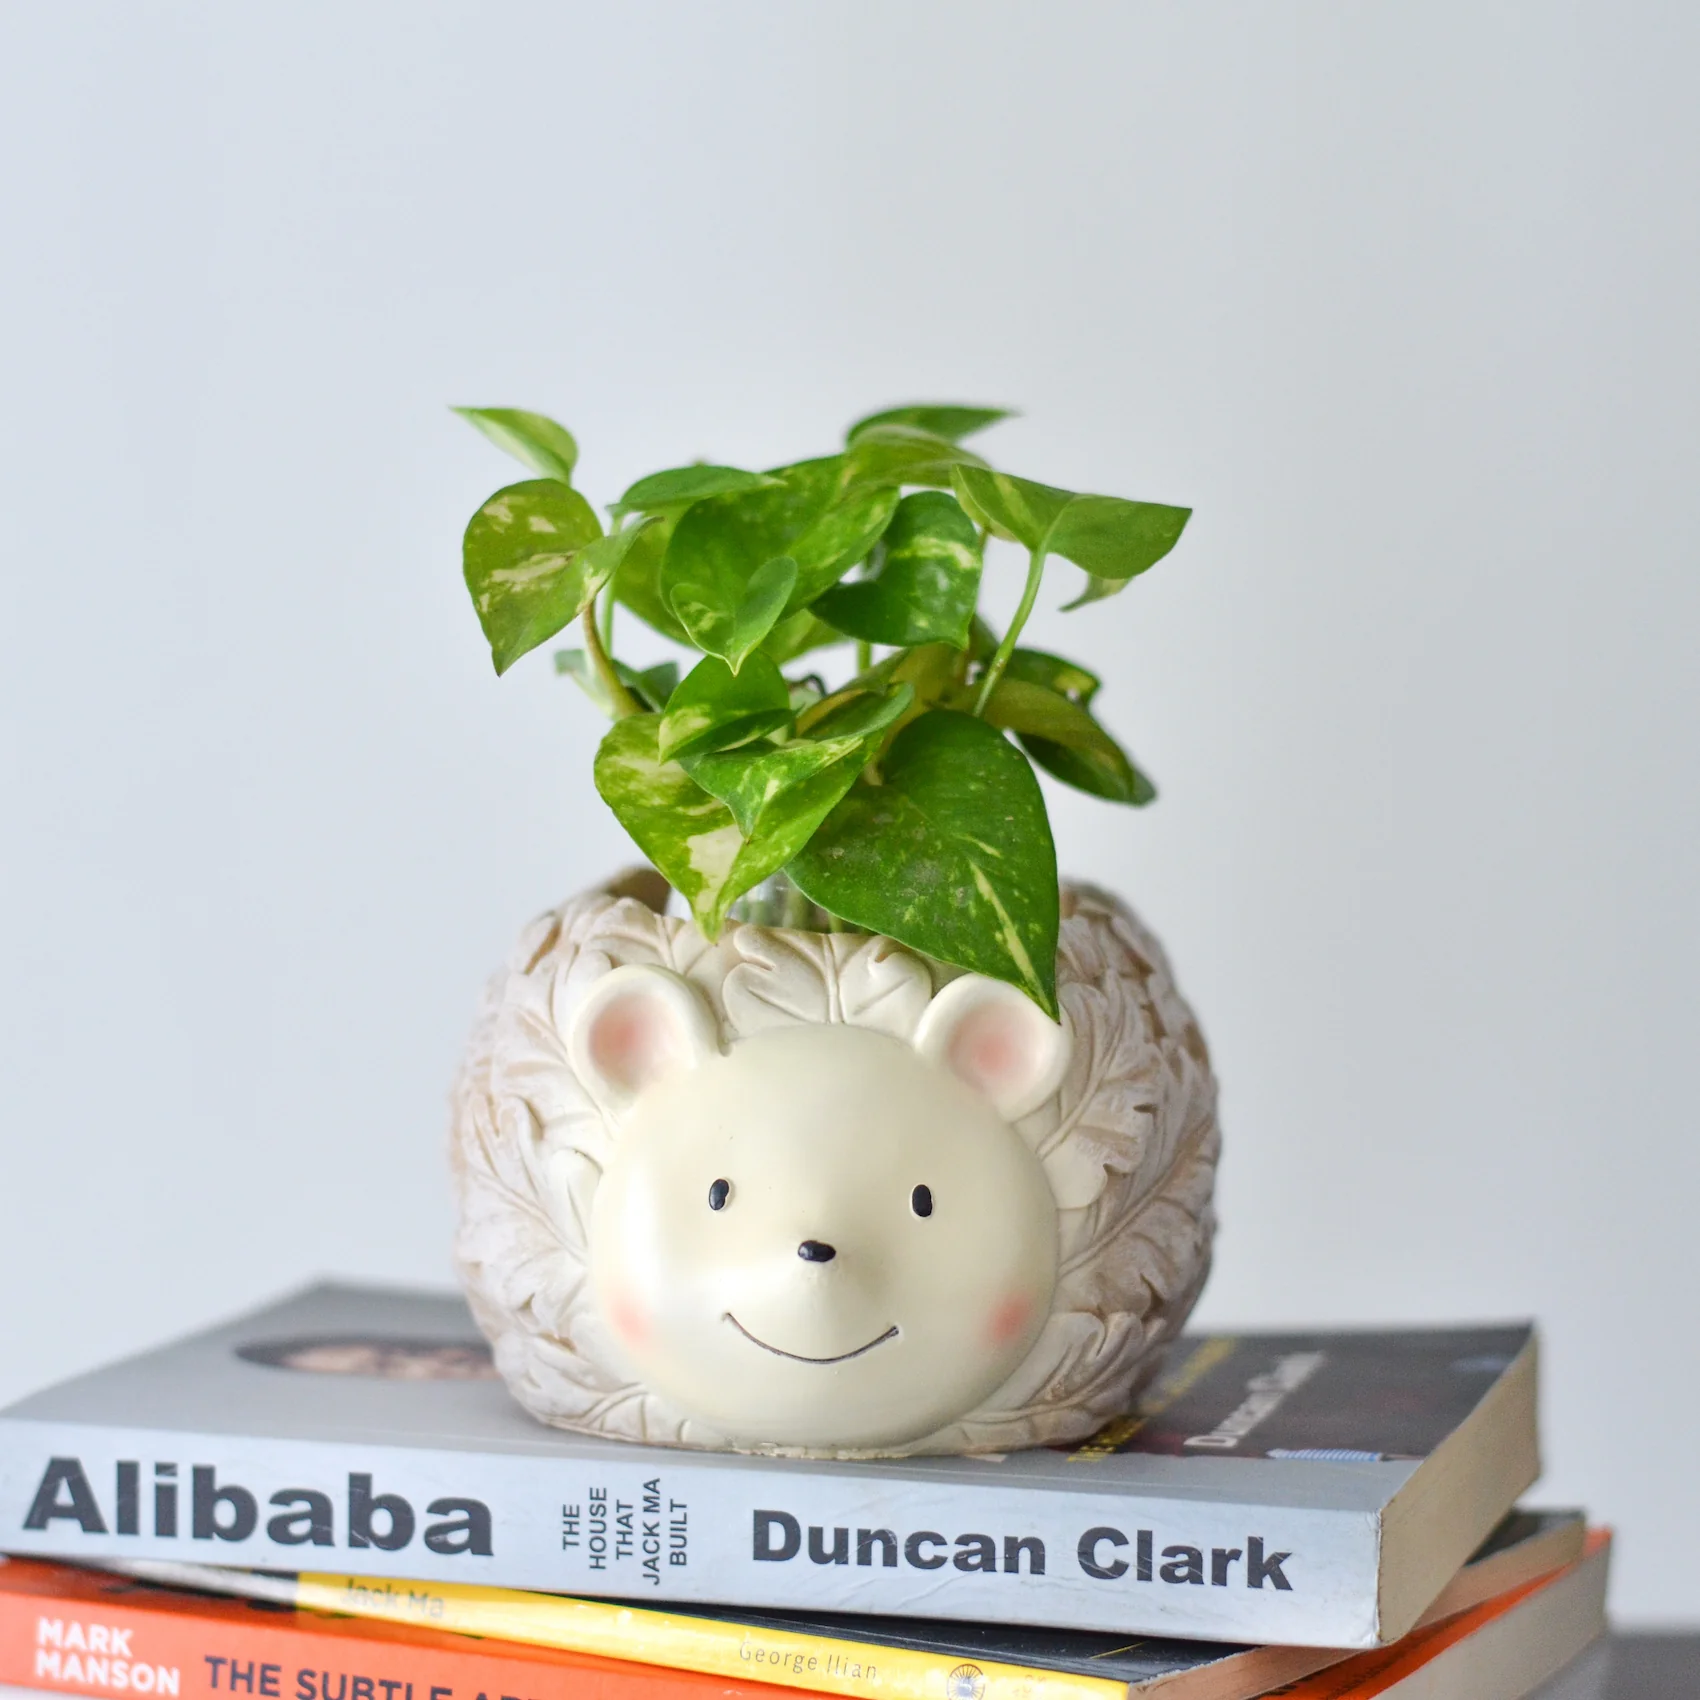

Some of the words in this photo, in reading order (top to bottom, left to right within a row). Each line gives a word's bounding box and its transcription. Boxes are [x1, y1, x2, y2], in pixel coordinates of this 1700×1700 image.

[22, 1456, 494, 1557] Alibaba
[642, 1477, 661, 1513] MA
[562, 1503, 580, 1550] THE
[588, 1486, 607, 1570] HOUSE
[615, 1498, 634, 1560] THAT
[669, 1498, 688, 1566] BUILT
[752, 1508, 1046, 1576] Duncan
[1076, 1525, 1294, 1592] Clark
[642, 1520, 661, 1586] JACK
[342, 1577, 399, 1609] Jack
[407, 1588, 446, 1619] Ma
[37, 1615, 134, 1658] MARK
[739, 1640, 818, 1675] George
[826, 1653, 878, 1680] Ilian
[35, 1647, 181, 1697] MANSON
[204, 1654, 283, 1698] THE
